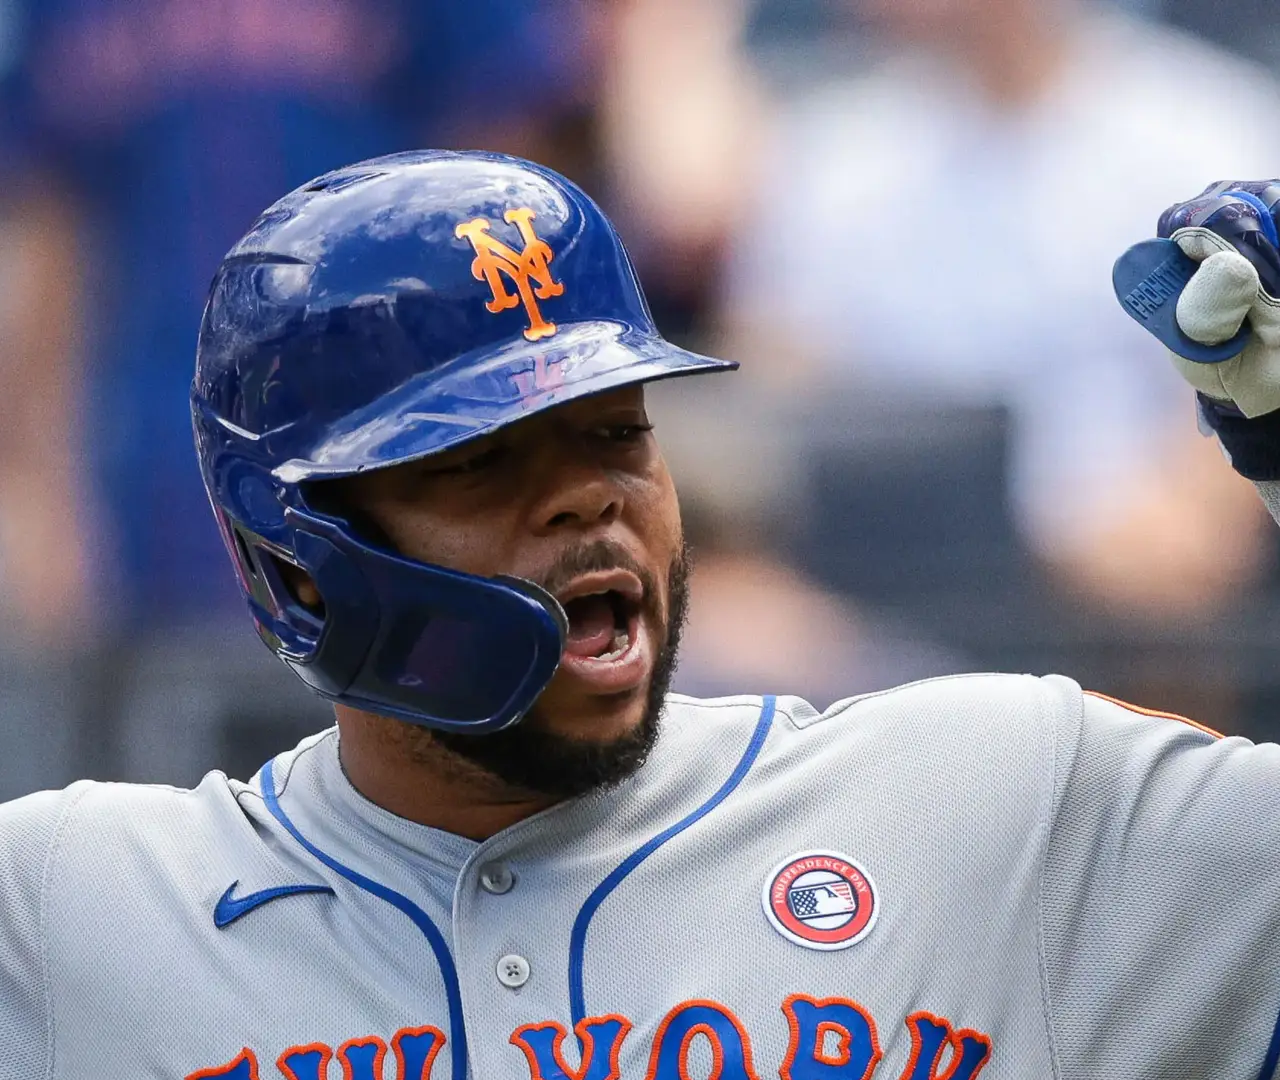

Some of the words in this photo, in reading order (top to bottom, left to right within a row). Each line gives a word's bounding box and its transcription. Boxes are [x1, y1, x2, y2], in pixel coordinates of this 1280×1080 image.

[455, 207, 565, 342] NY
[775, 859, 848, 904] INDEPENDENCE
[850, 872, 868, 894] DAY
